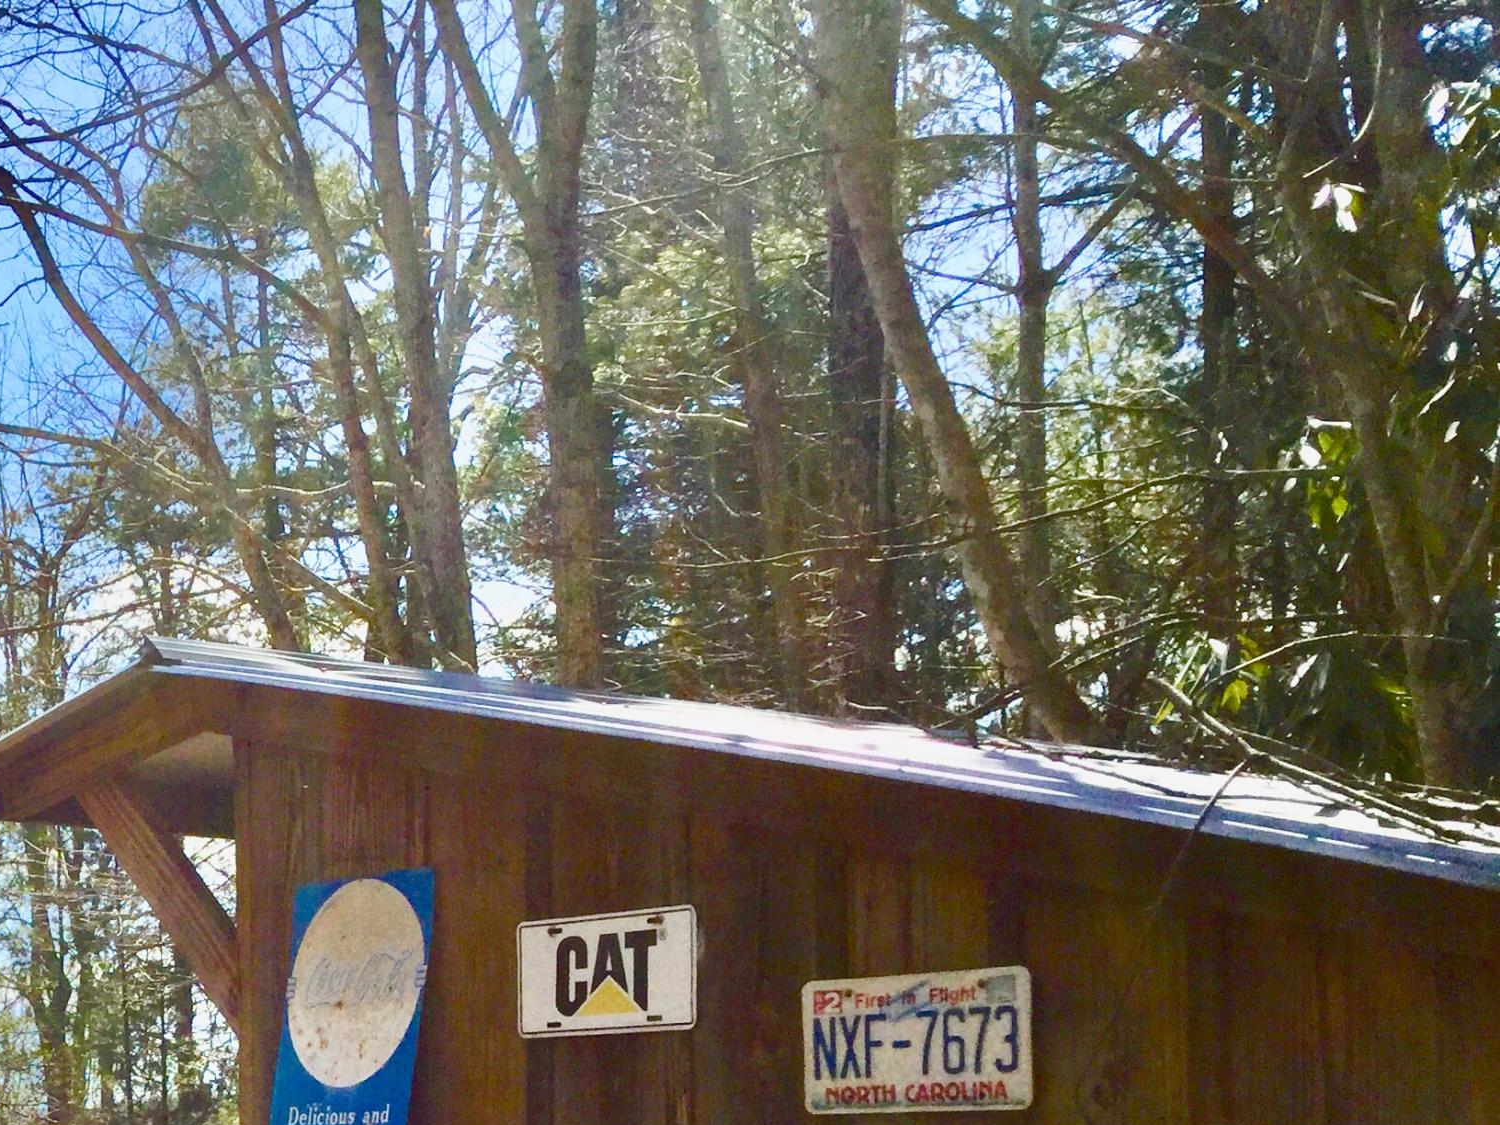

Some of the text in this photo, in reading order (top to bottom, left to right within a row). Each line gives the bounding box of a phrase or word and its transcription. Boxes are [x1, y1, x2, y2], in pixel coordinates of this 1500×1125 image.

[556, 929, 658, 1017] CAT
[854, 992, 892, 1010] First
[928, 984, 977, 1007] Flight
[812, 1005, 1020, 1080] NXF-7673
[825, 1080, 1009, 1106] NORTH CAROLINA
[362, 1103, 391, 1124] and
